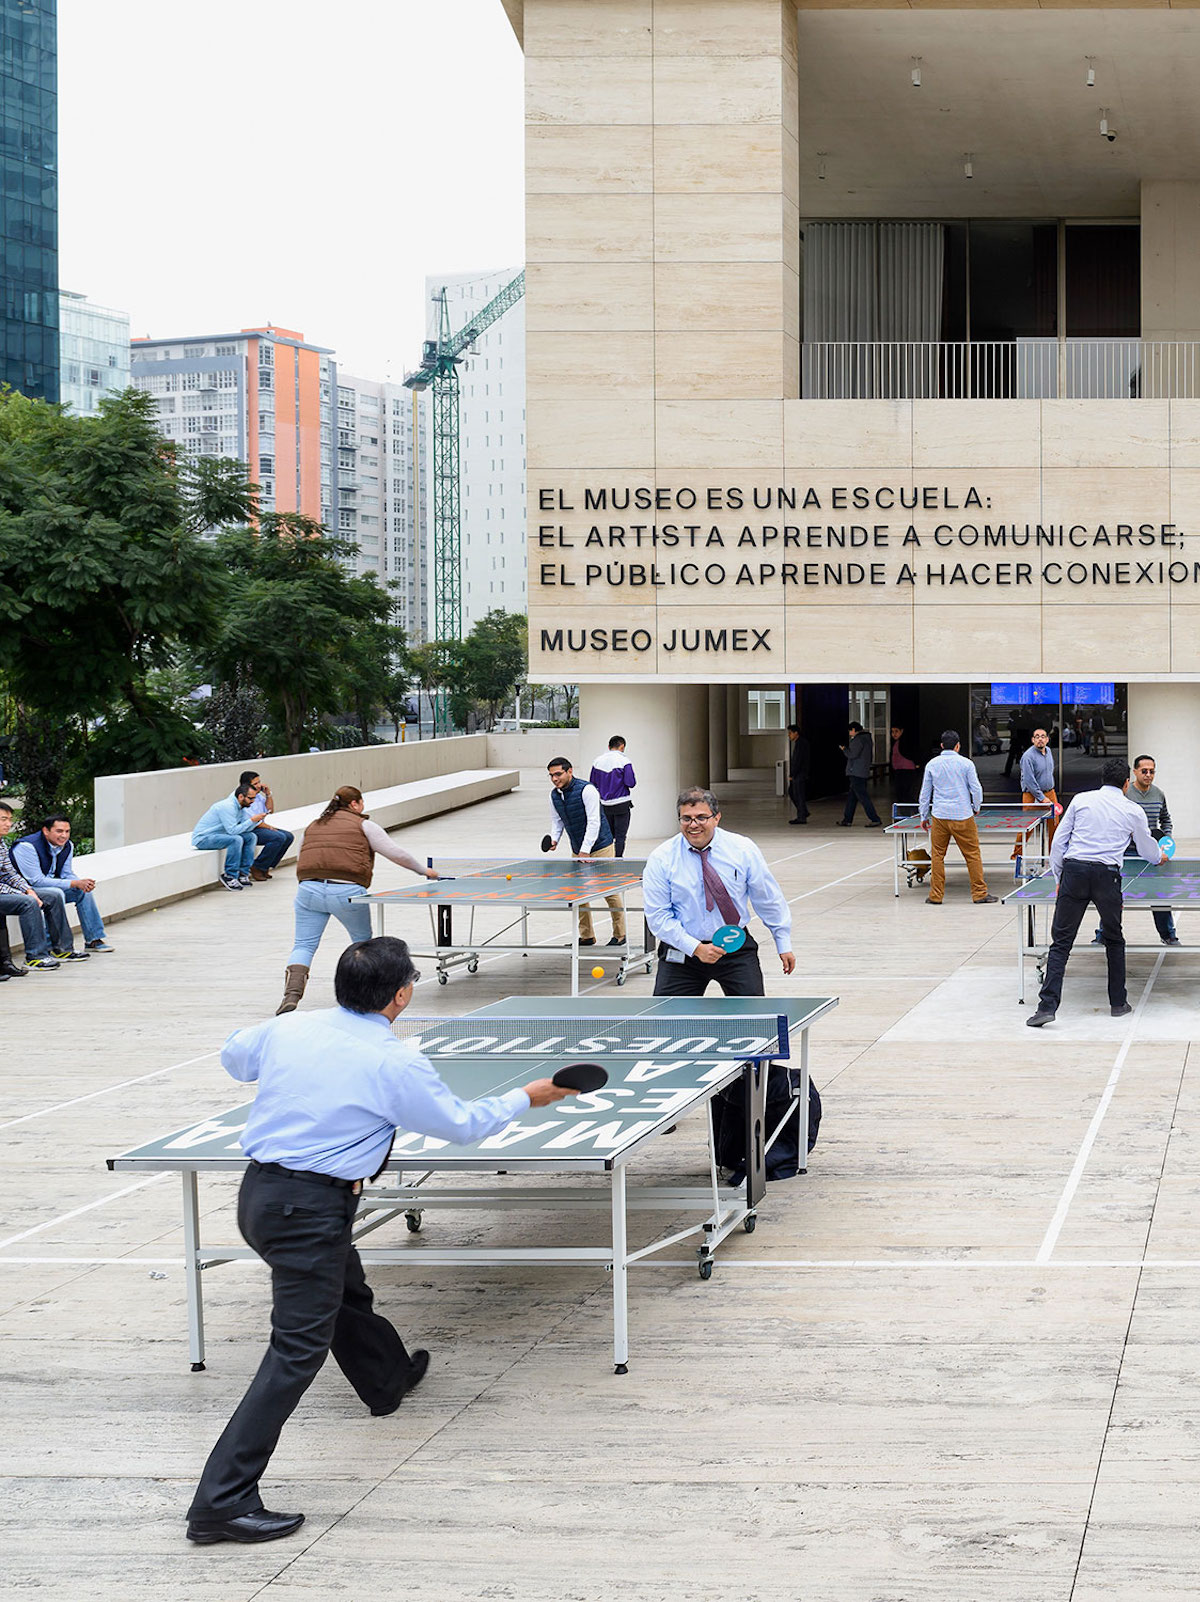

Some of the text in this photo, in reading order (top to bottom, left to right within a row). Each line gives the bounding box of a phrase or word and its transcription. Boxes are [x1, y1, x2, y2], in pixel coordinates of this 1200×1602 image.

[539, 487, 992, 510] EL MUSEO ES UNA ESCUELA:
[539, 525, 1185, 549] EL ARTISTA APRENDE A COMUNICARSE;
[540, 564, 575, 586] EL
[585, 561, 726, 586] PÚBLICO
[735, 563, 886, 586] APRENDE
[896, 563, 915, 585] A
[926, 563, 1033, 585] HACER
[541, 629, 772, 651] MUSEO JUMEX
[624, 1060, 736, 1083] LA
[556, 1088, 702, 1114] ES
